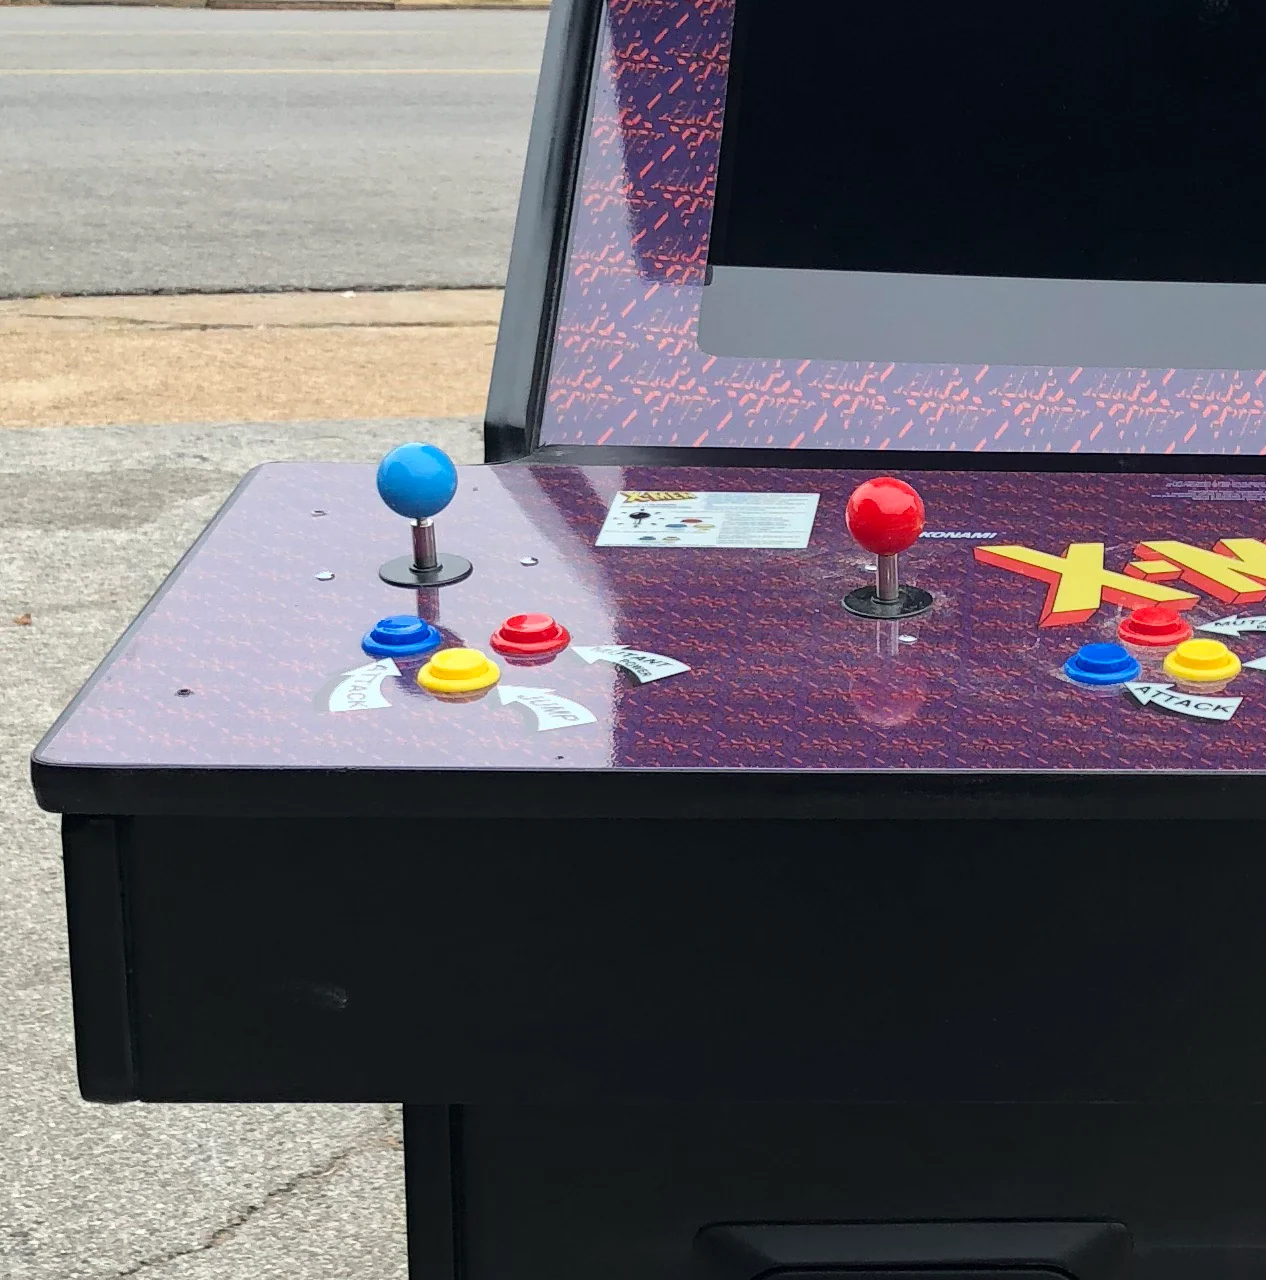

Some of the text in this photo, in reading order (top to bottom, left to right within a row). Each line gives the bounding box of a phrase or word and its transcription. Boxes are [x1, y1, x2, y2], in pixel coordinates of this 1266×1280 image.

[919, 531, 998, 539] KONAMI
[620, 658, 652, 677] POWER
[347, 664, 388, 709] ATTACK
[1134, 685, 1236, 713] ATTACK
[517, 693, 580, 722] JUMP
